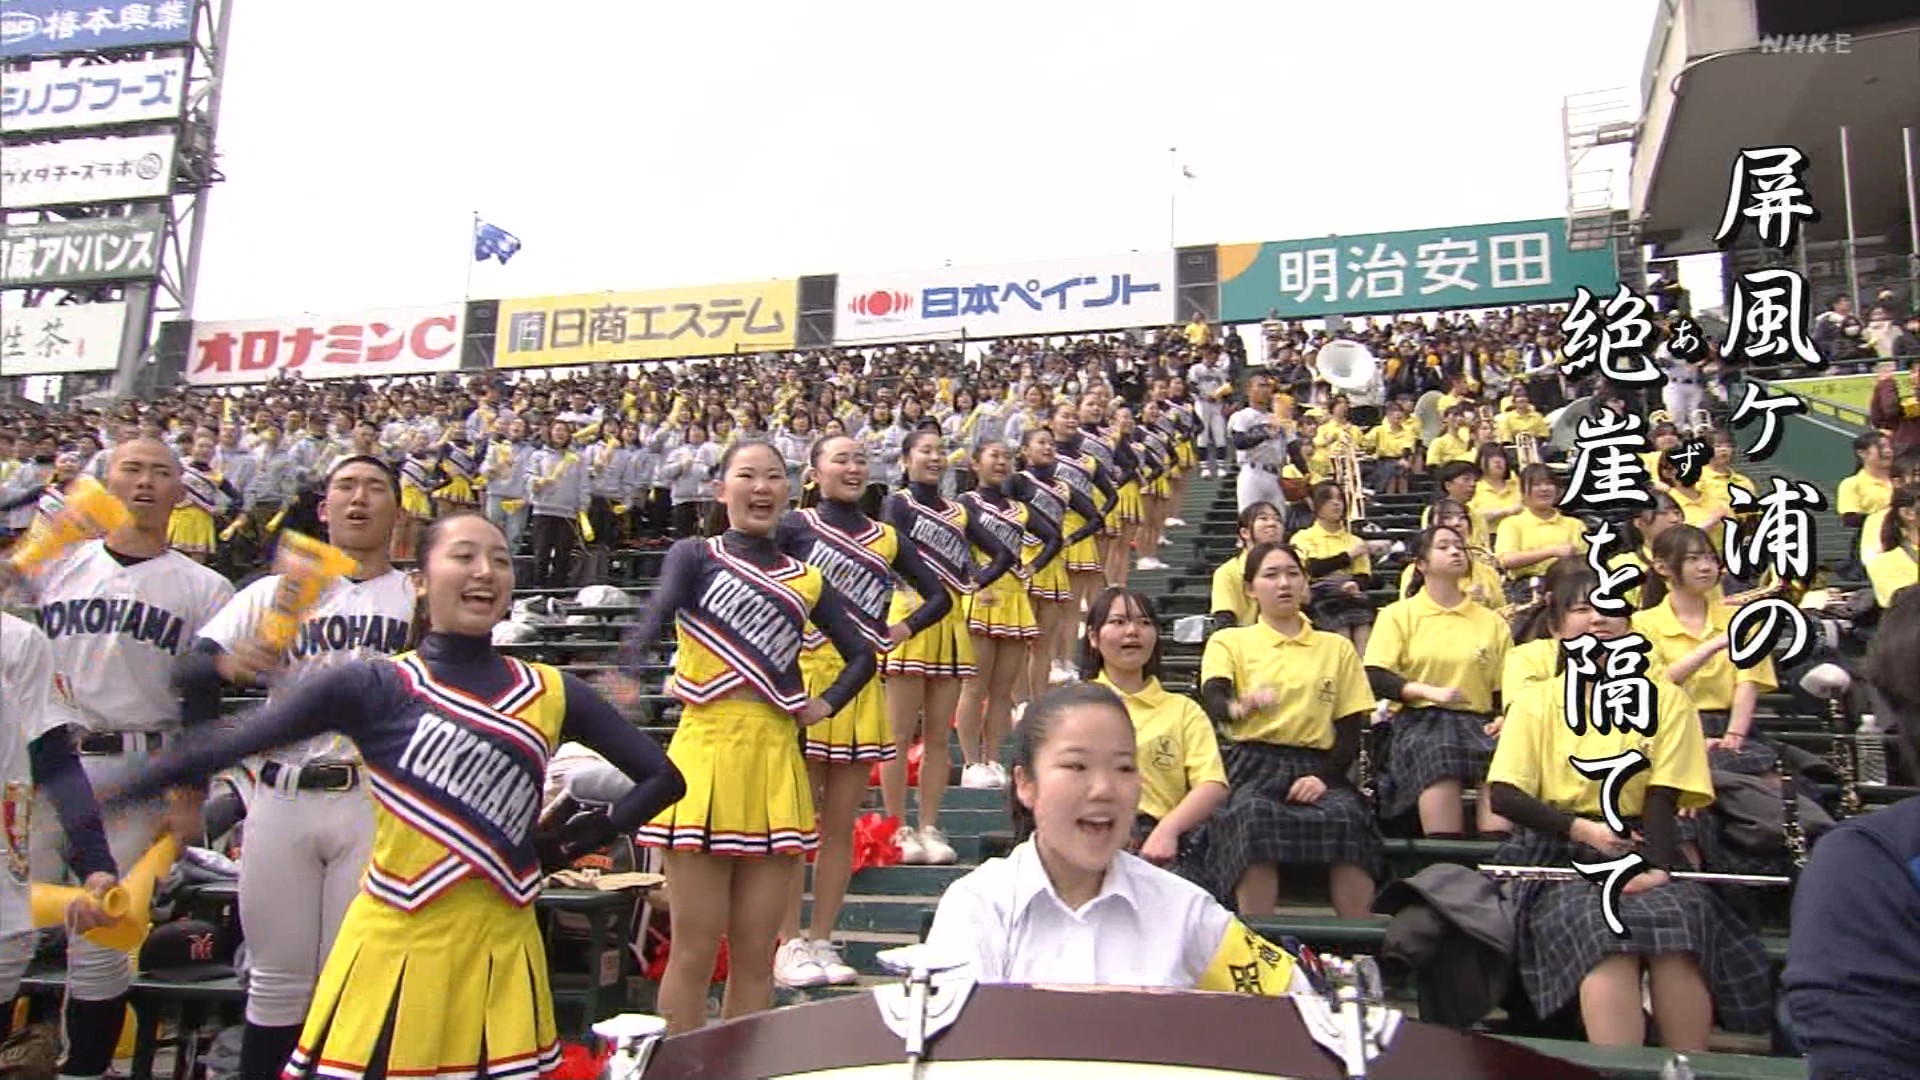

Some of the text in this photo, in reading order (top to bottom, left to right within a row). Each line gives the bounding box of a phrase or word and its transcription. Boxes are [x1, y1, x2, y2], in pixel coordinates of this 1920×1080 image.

[1, 70, 177, 116] シノブフーズ
[921, 274, 1161, 319] 日本ペイント
[1279, 232, 1552, 302] 明治安田
[194, 315, 456, 373] オロナミンC
[551, 297, 784, 349] 日商エステム
[807, 539, 885, 619] YOKOHAMA
[700, 569, 801, 673] YOKOHAMA
[398, 713, 540, 846] YOKOHAMA
